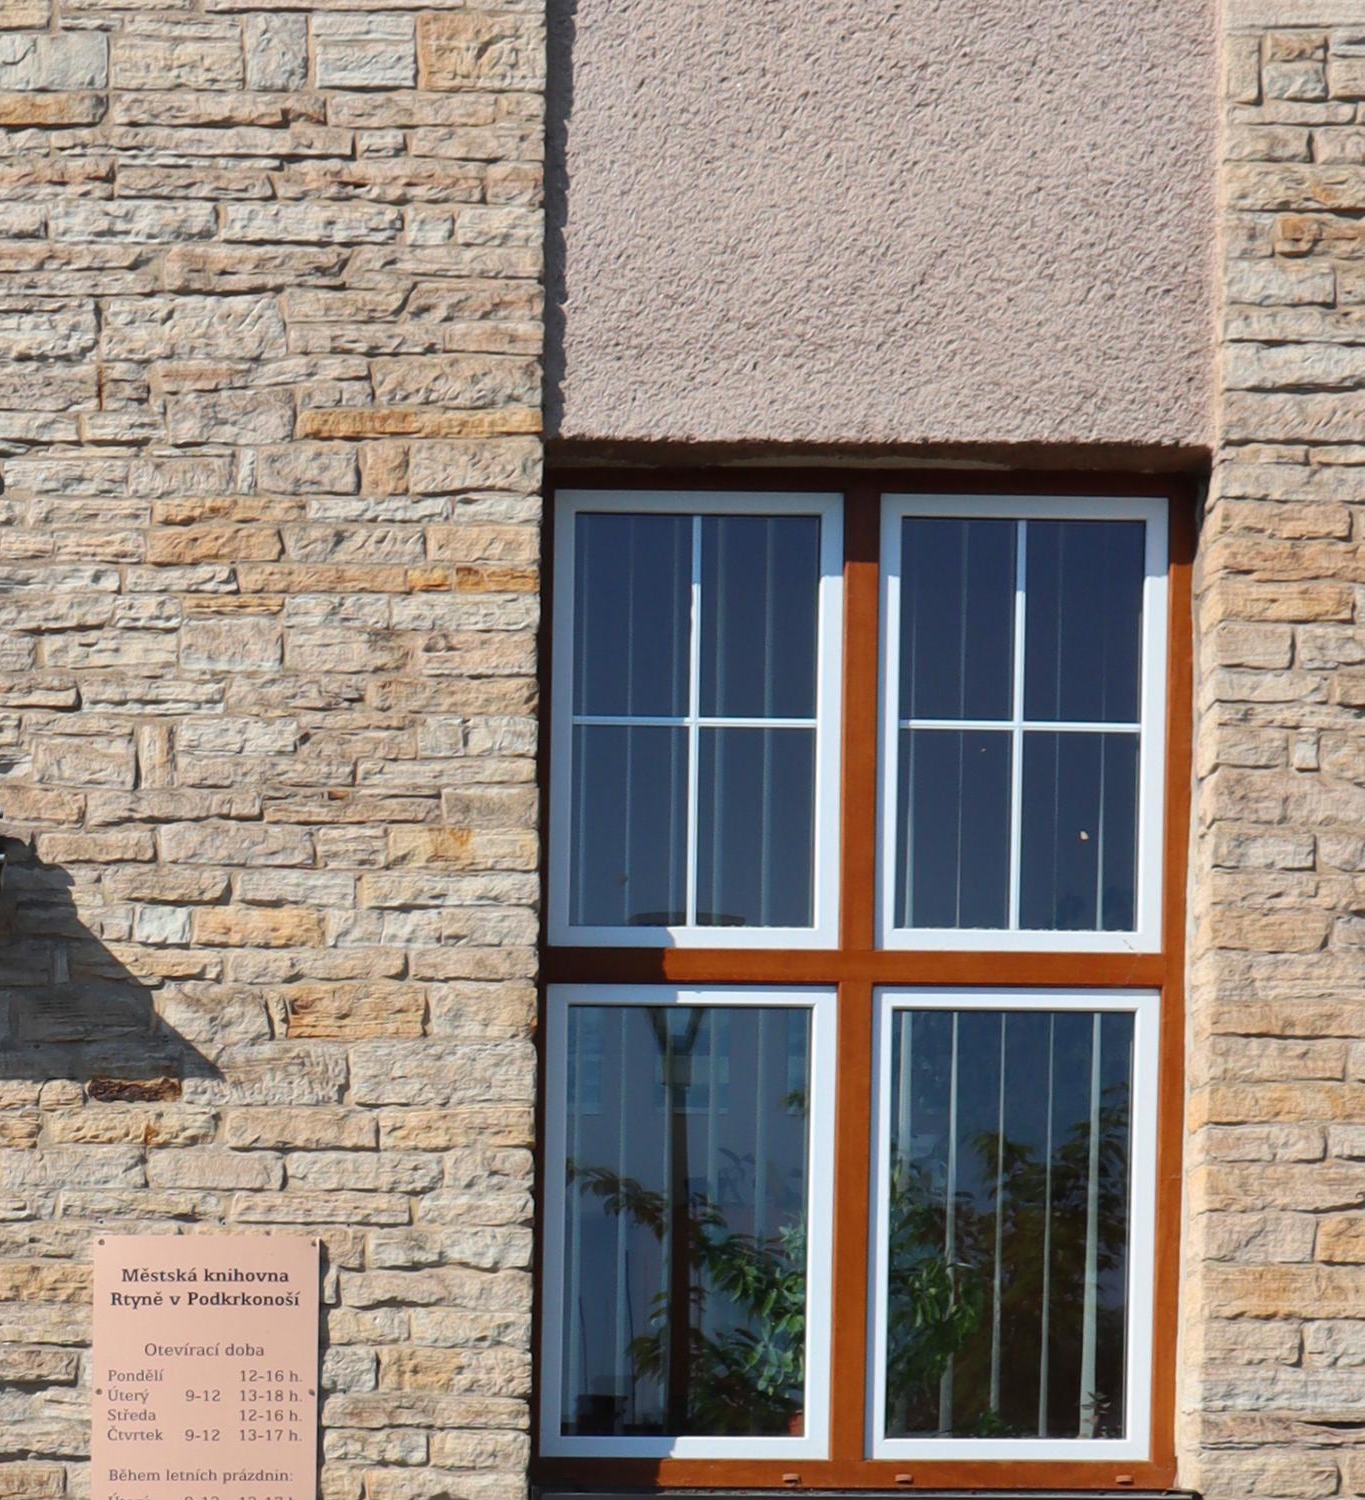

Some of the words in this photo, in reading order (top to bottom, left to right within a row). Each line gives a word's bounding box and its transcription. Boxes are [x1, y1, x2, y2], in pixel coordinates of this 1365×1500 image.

[121, 1268, 198, 1283] Městská
[204, 1269, 289, 1283] knihovna
[111, 1291, 163, 1309] Rtyně
[170, 1295, 181, 1306] v
[187, 1291, 301, 1306] Podkrkonoší
[144, 1343, 219, 1357] Otevírací
[225, 1343, 265, 1357] doba
[107, 1369, 163, 1382] Pondělí
[240, 1370, 284, 1382] 12-16
[289, 1370, 303, 1382] h.
[107, 1388, 149, 1404] Úterý
[185, 1390, 221, 1402] 9-12
[240, 1390, 284, 1402] 13-18
[289, 1390, 303, 1402] h.
[107, 1409, 156, 1422] Středa
[240, 1410, 284, 1422] 12-16
[289, 1410, 303, 1422] h.
[107, 1427, 163, 1442] Čtvrtek
[185, 1429, 221, 1441] 9-12
[240, 1429, 283, 1441] 13-17
[289, 1429, 302, 1441] h.
[108, 1469, 161, 1482] Během
[166, 1469, 217, 1482] letních
[223, 1469, 293, 1485] prázdnin:
